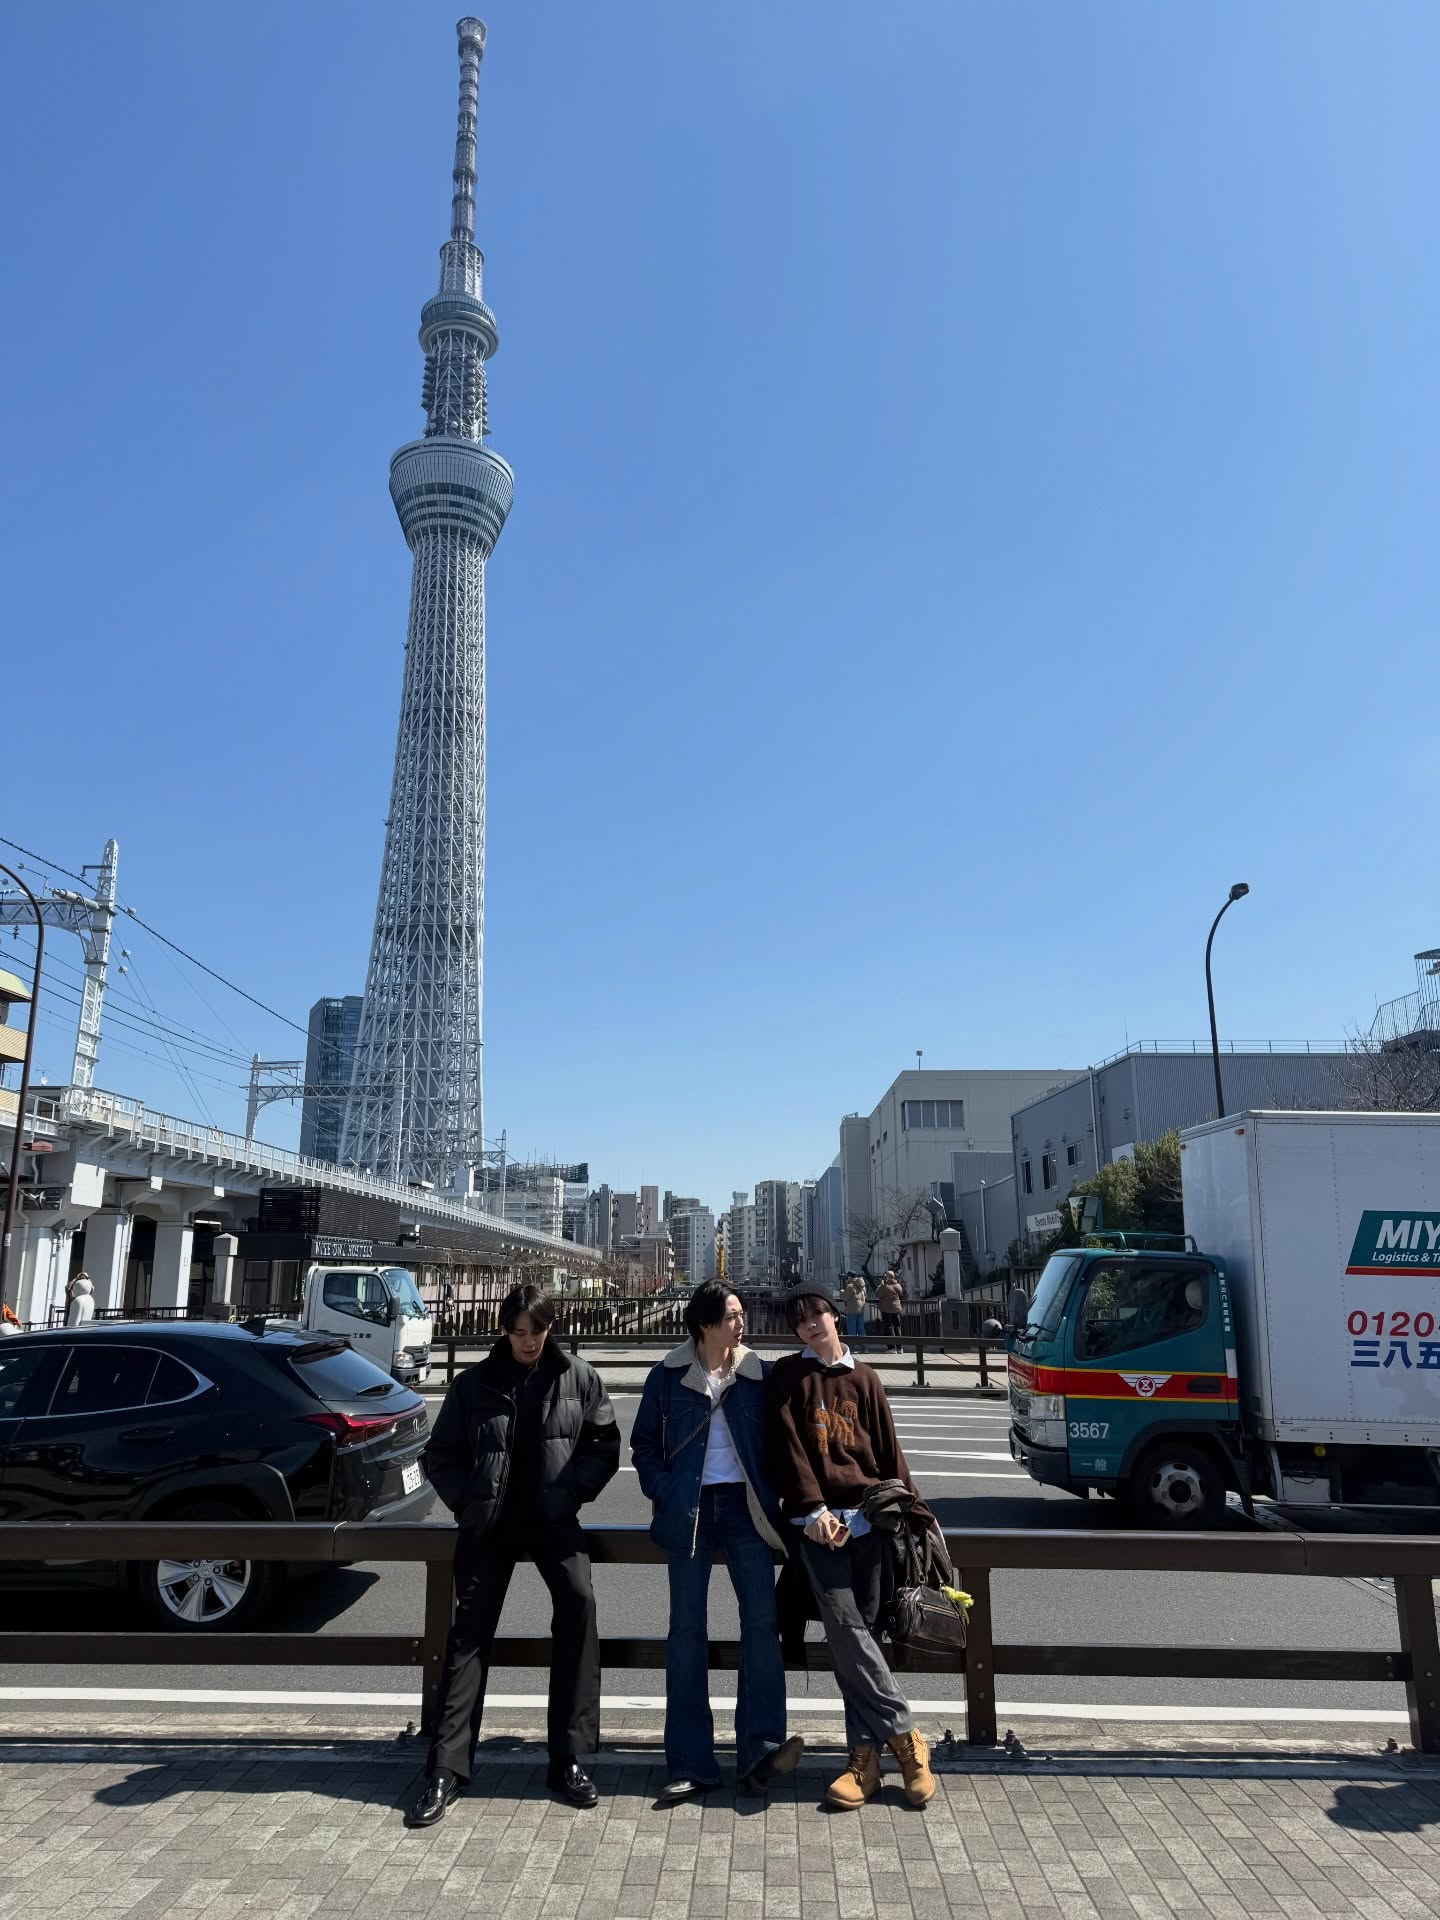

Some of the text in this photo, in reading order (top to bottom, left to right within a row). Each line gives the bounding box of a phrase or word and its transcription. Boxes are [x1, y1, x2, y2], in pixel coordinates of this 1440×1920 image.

[1375, 1219, 1440, 1250] MIY
[1371, 1251, 1420, 1264] Logistics
[1420, 1252, 1430, 1263] &
[1347, 1310, 1440, 1338] 0120
[1350, 1339, 1440, 1370] 三八五
[1069, 1421, 1110, 1439] 3567
[1079, 1458, 1108, 1472] 一般
